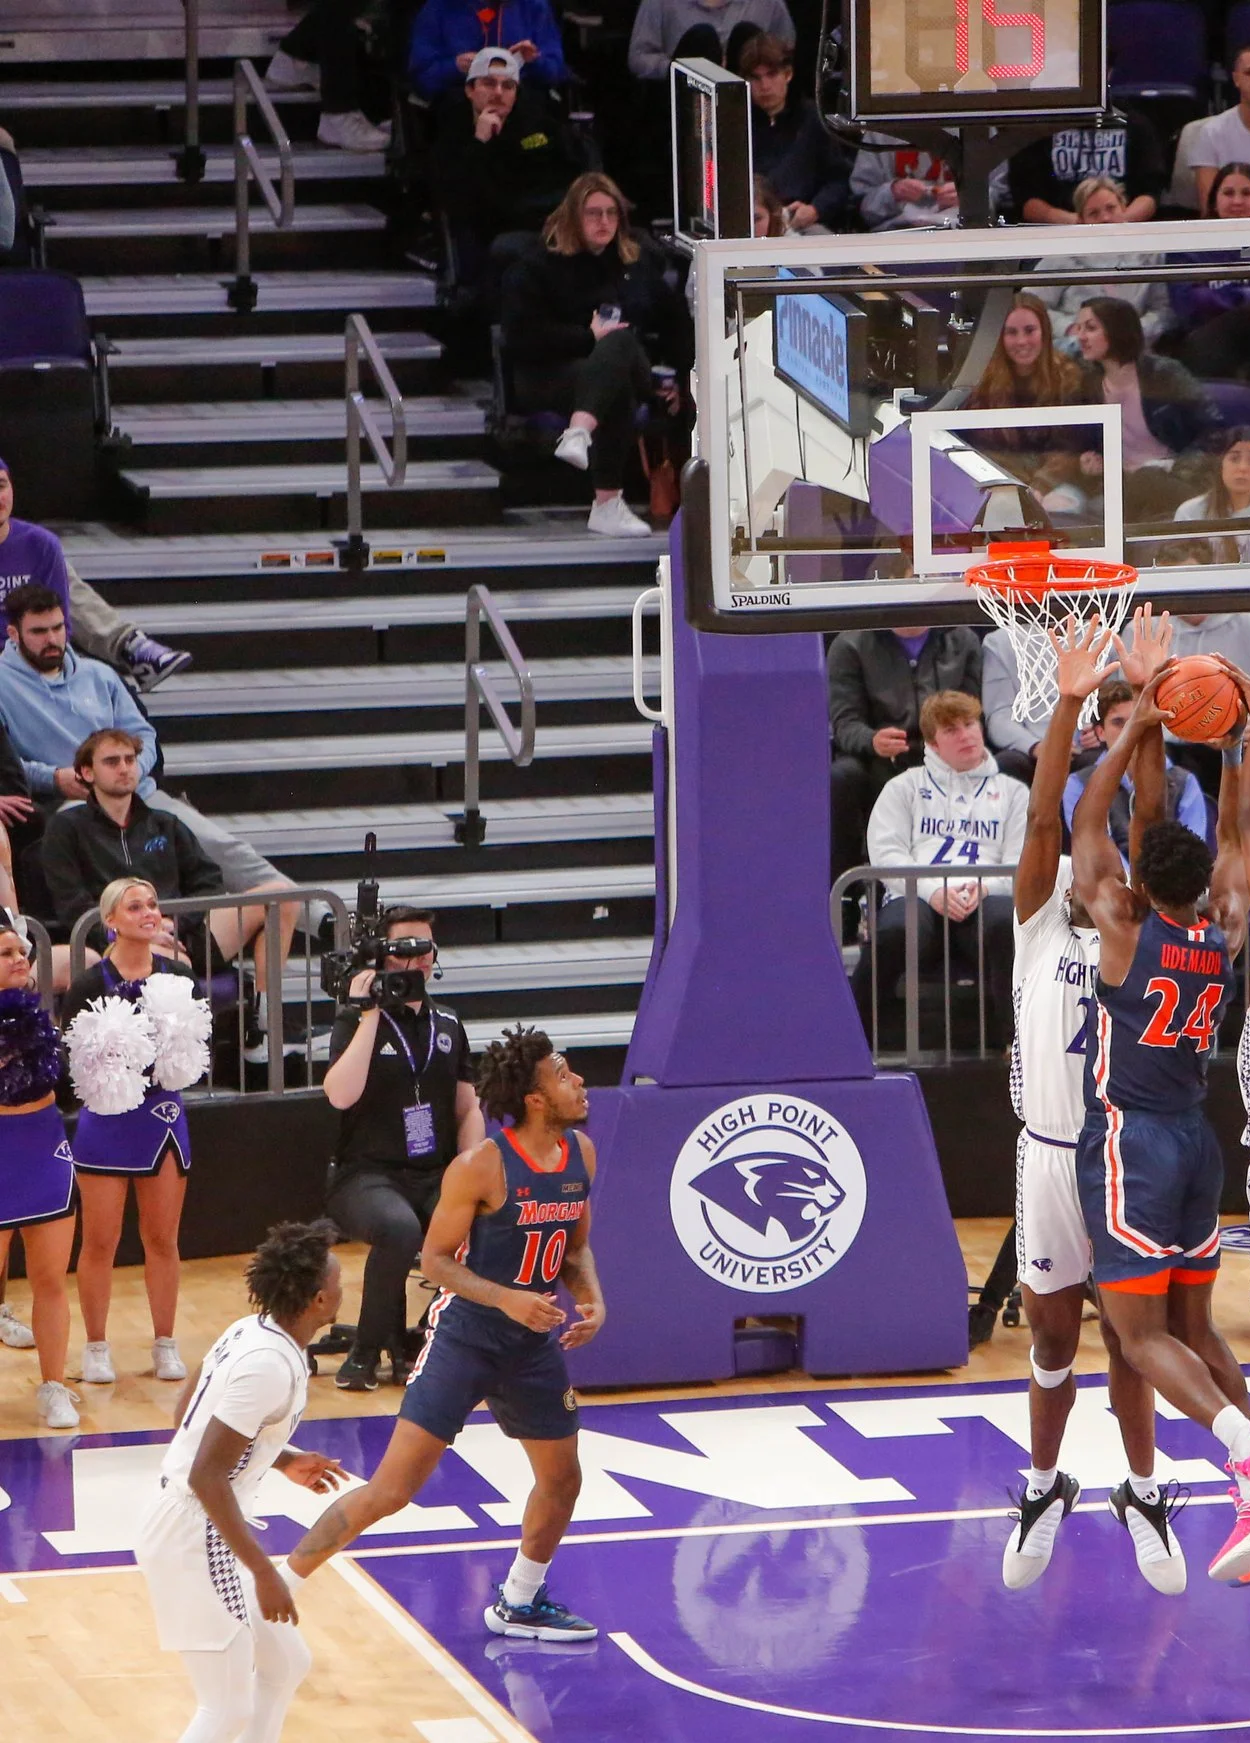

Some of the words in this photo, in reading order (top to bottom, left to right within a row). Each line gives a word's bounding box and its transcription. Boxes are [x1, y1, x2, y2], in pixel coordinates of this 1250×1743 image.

[0, 574, 31, 589] OINT
[731, 592, 791, 608] SPALDING
[930, 835, 980, 865] 24
[1160, 943, 1222, 976] UDEMADU
[1137, 977, 1225, 1053] 24
[696, 1104, 756, 1153] HIGH
[768, 1102, 839, 1145] POINT
[513, 1229, 567, 1286] 10
[699, 1236, 837, 1285] UNIVERSITY
[183, 1370, 215, 1431] 1
